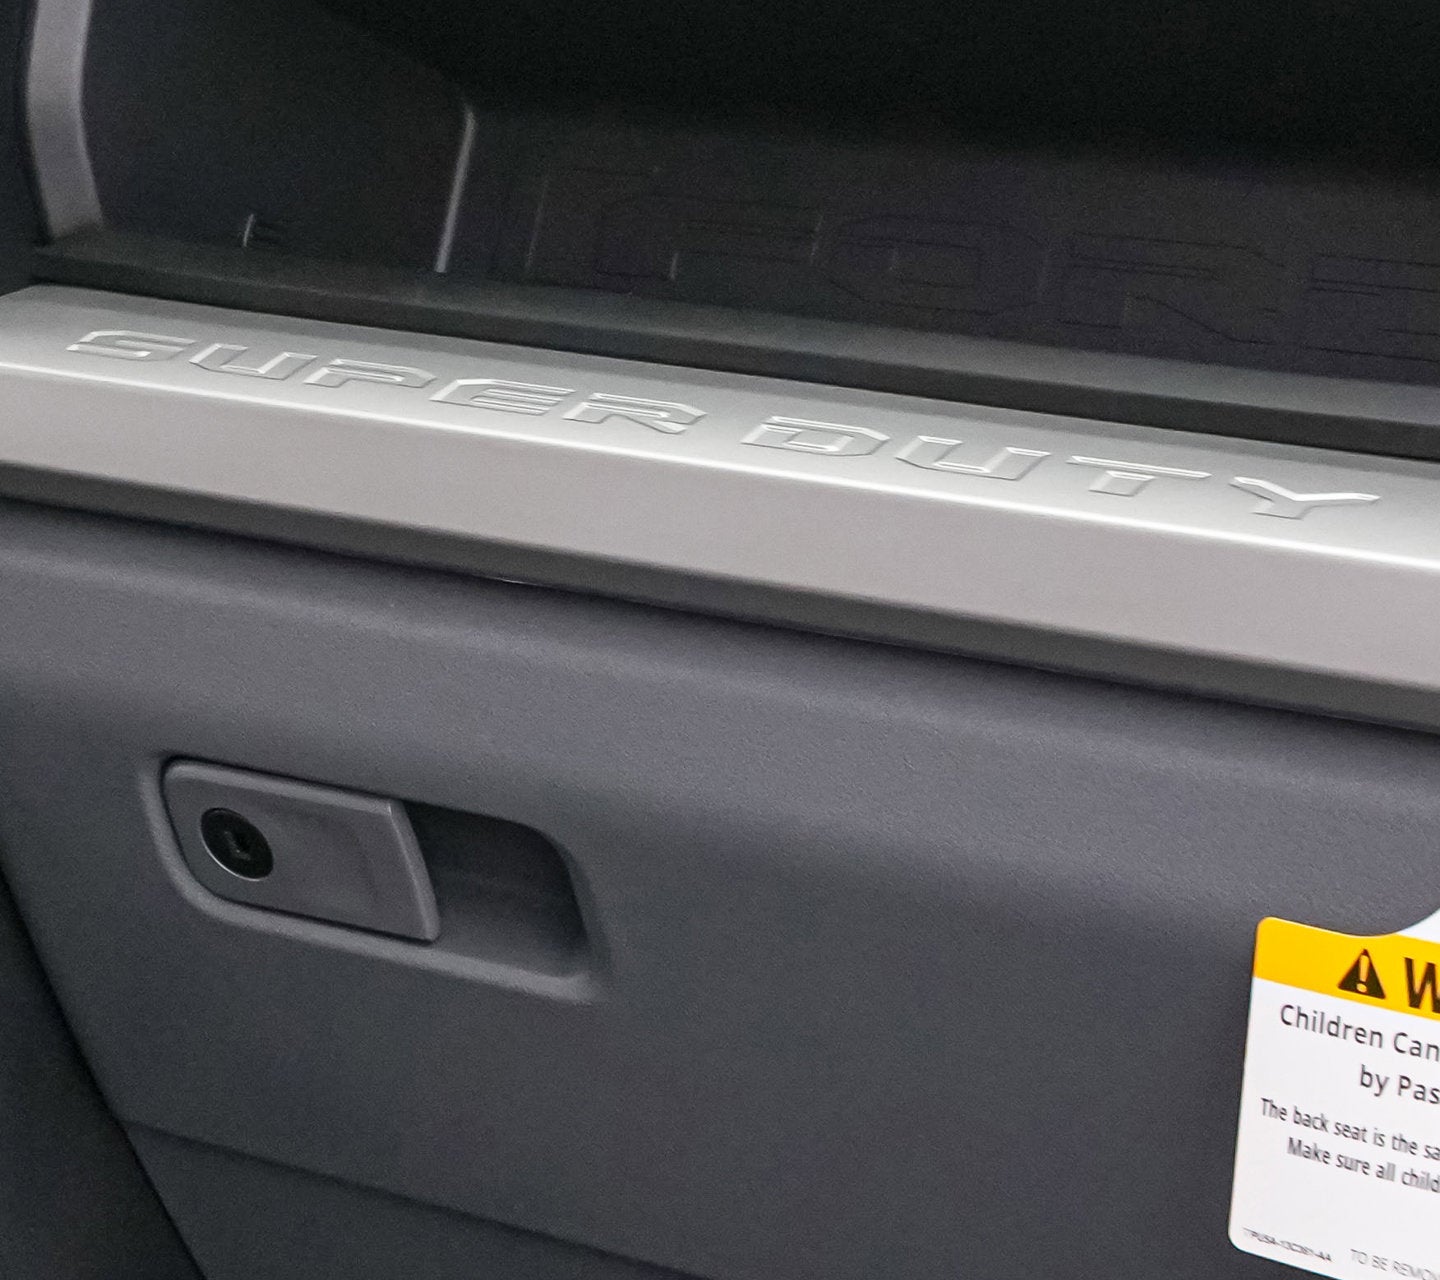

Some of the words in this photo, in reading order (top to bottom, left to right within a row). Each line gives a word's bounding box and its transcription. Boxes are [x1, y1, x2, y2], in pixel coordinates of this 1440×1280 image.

[66, 329, 707, 435] SUPER
[741, 414, 1381, 520] DUTY
[1280, 1004, 1384, 1049] Children
[1393, 1032, 1440, 1062] Can
[1360, 1064, 1390, 1097] by
[1261, 1097, 1287, 1122] The
[1293, 1106, 1328, 1132] back
[1333, 1120, 1367, 1144] seat
[1373, 1127, 1385, 1147] is
[1392, 1133, 1418, 1156] the
[1287, 1137, 1331, 1164] Make
[1336, 1152, 1370, 1175] sure
[1376, 1162, 1395, 1182] all
[1351, 1249, 1368, 1265] TO
[1372, 1255, 1388, 1271] BE
